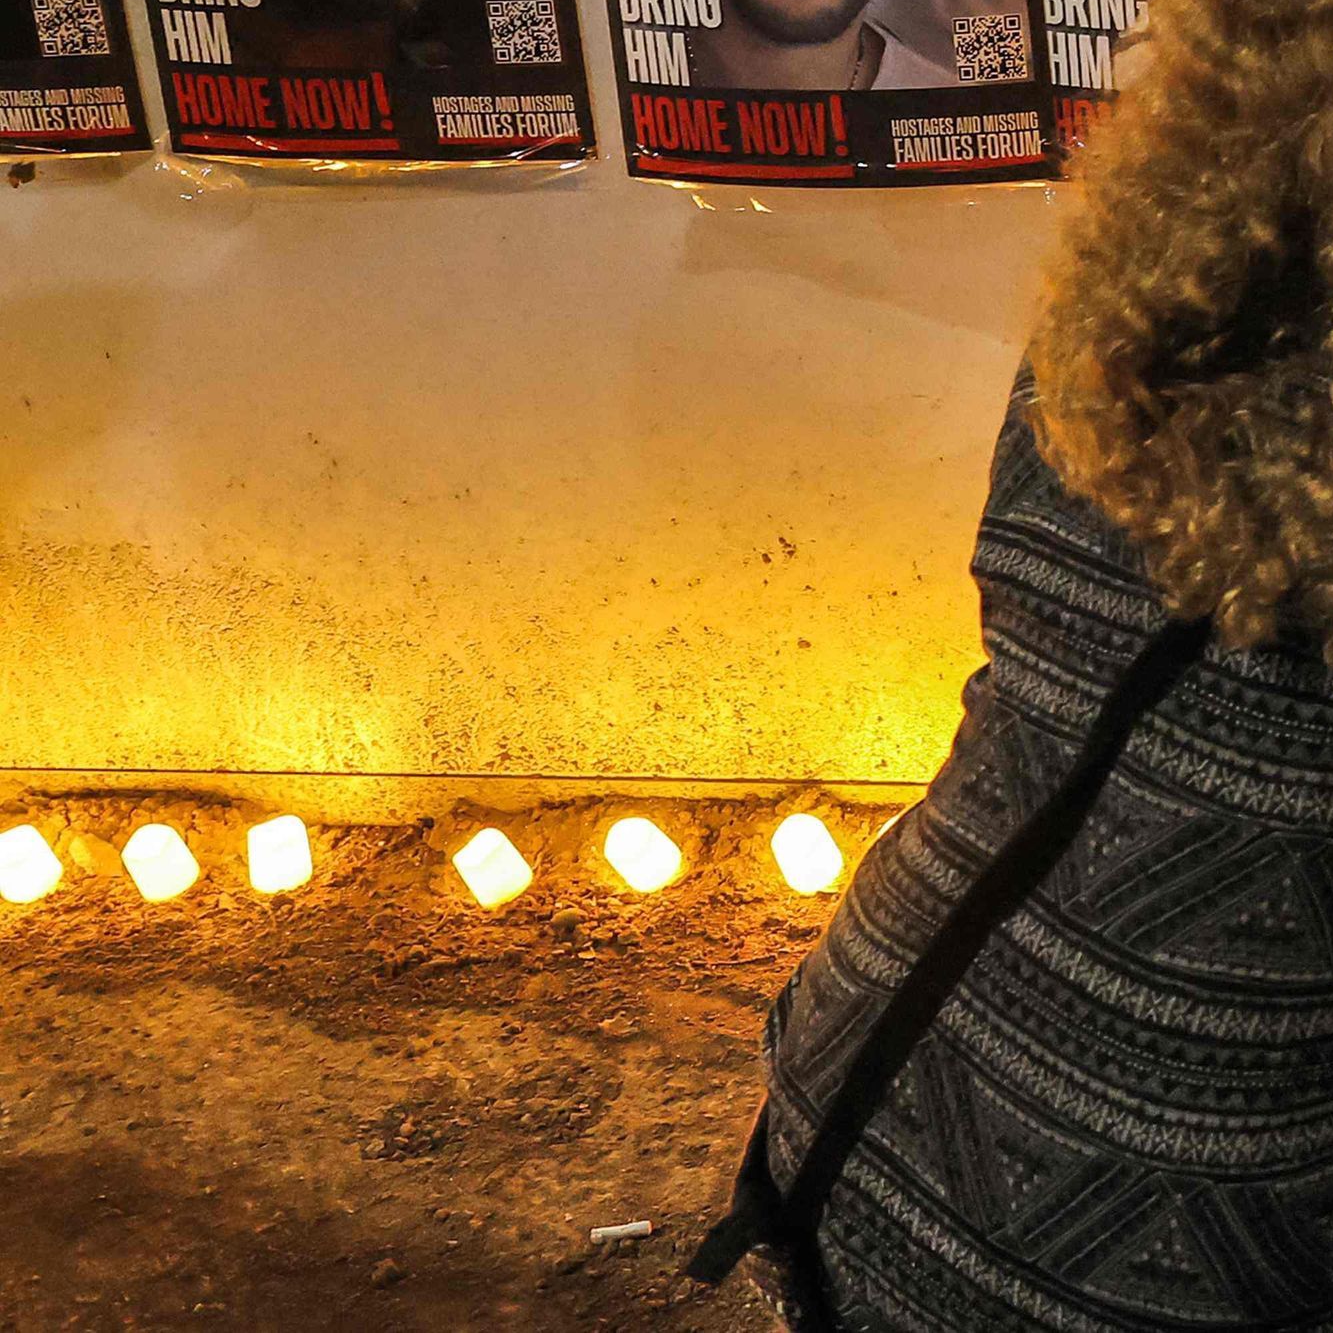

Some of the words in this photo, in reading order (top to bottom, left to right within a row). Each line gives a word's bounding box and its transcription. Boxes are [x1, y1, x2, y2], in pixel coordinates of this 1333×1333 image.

[161, 9, 232, 64] HIM
[173, 73, 276, 128] HOME
[281, 72, 393, 131] NOW!
[891, 118, 953, 137] HOSTAGES
[957, 116, 981, 134] AND
[983, 112, 1038, 133] MISSING
[894, 135, 973, 163] FAMILIES
[977, 132, 1042, 160] FORUM
